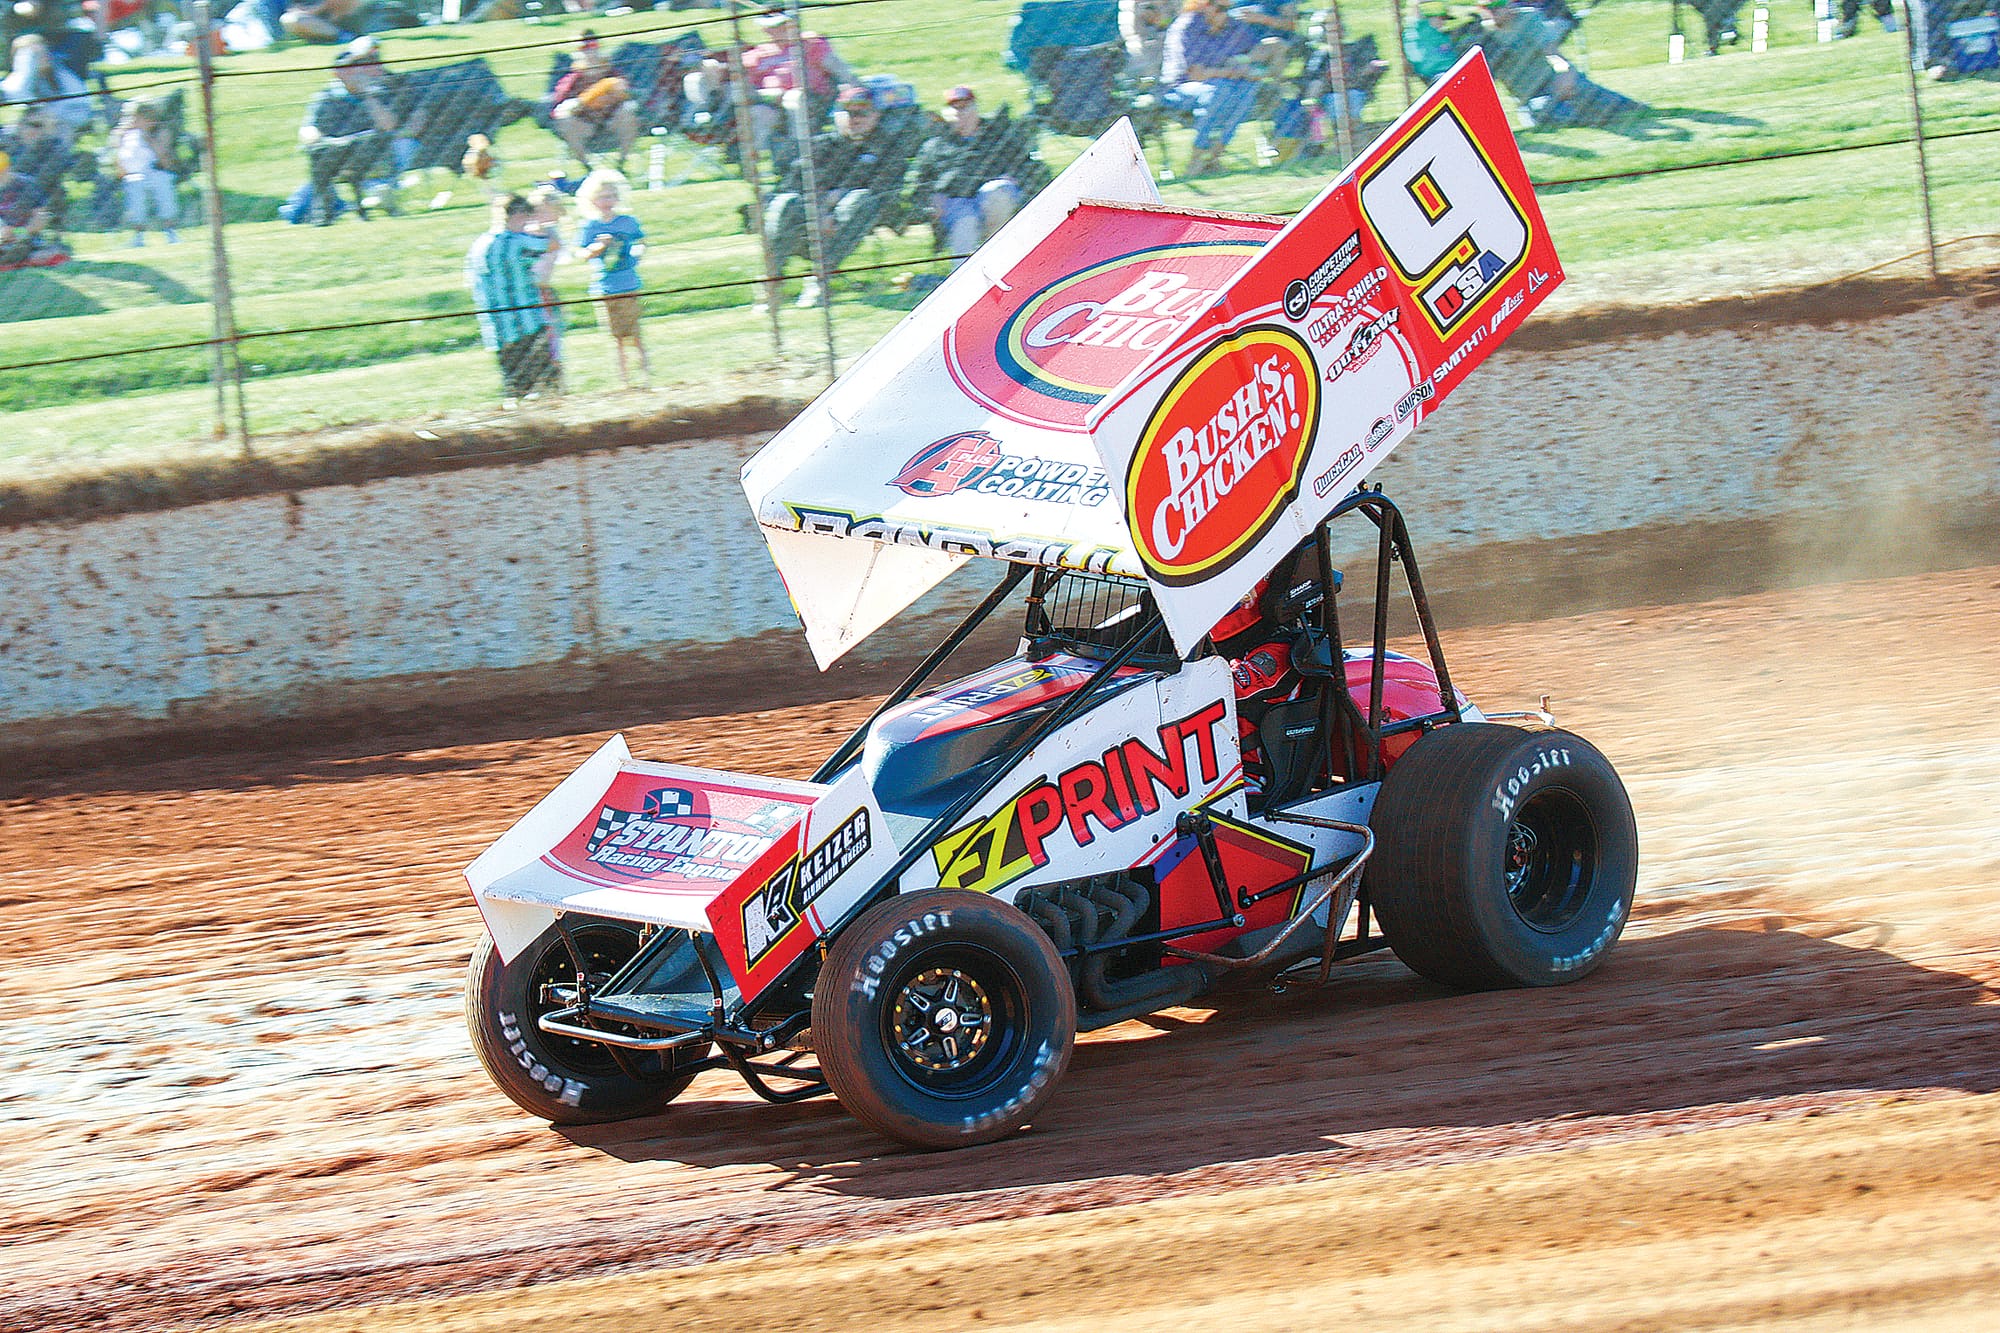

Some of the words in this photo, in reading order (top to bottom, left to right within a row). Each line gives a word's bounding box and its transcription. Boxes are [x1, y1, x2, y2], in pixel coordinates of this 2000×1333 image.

[1359, 100, 1530, 338] 9
[1308, 233, 1358, 287] COMPETITION
[1310, 256, 1351, 299] SUSPENSION
[1346, 266, 1388, 306] SHIELD
[1433, 249, 1507, 320] USA
[1328, 308, 1399, 381] OUTLAW
[1161, 354, 1282, 496] BUSH'S
[1397, 382, 1433, 418] SIMPSON
[977, 475, 1109, 507] COATING
[1152, 373, 1300, 561] CHICKEN!
[587, 845, 668, 873] Racing
[801, 812, 866, 888] KEIZER
